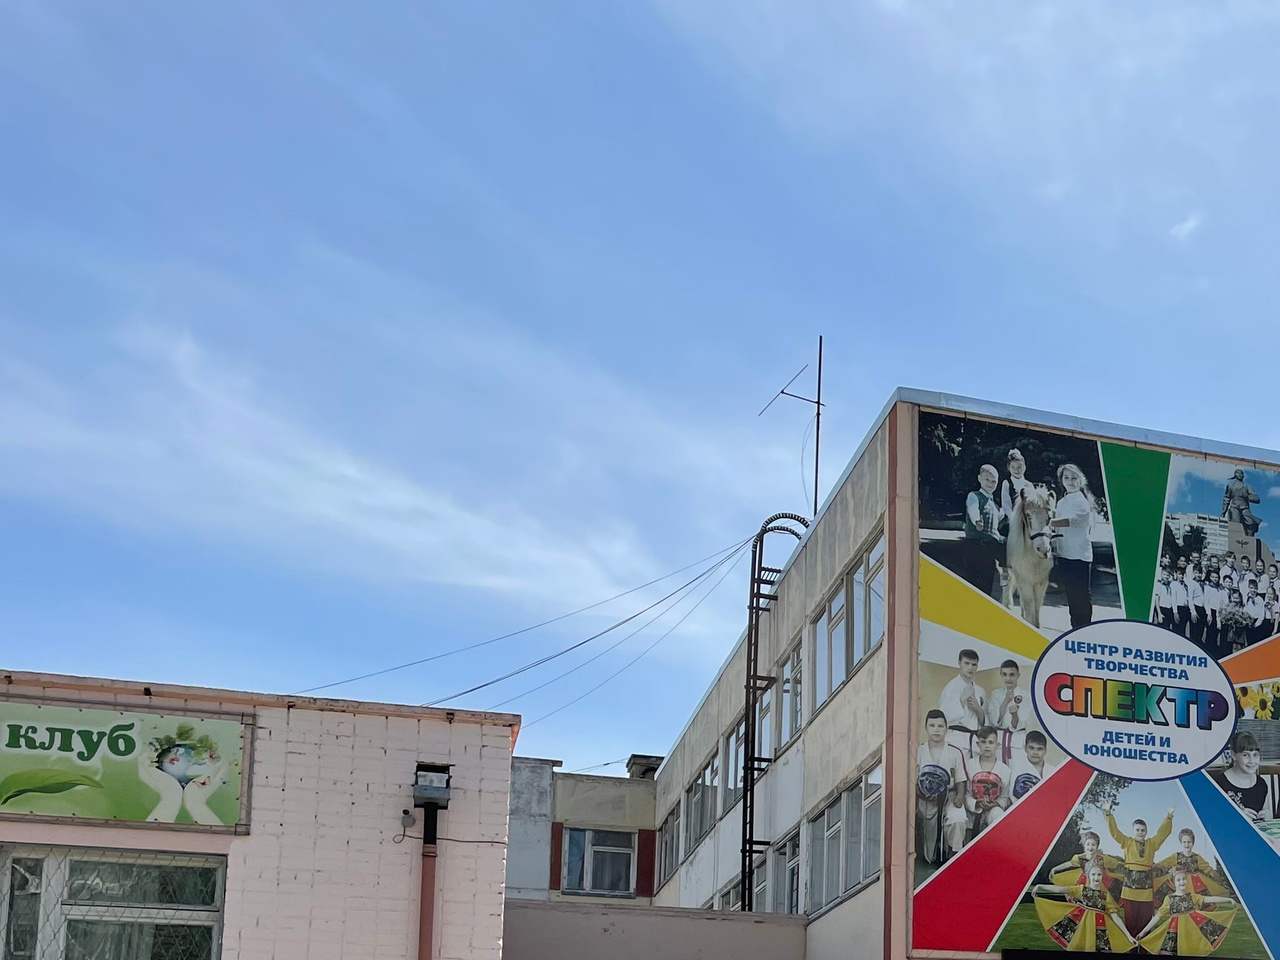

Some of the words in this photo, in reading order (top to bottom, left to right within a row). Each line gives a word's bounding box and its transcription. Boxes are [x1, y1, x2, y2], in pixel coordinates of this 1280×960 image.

[1064, 639, 1119, 656] ЦЕНТР
[1122, 649, 1208, 668] РАЗВИТИЯ
[1084, 657, 1189, 681] ТВОРЧЕСТВА
[1044, 673, 1229, 730] СПЕКТР
[5, 722, 136, 761] клуб
[1102, 731, 1156, 748] ДЕТЕЙ
[1159, 735, 1171, 748] И
[1084, 744, 1189, 765] ЮНОШЕСТВА
